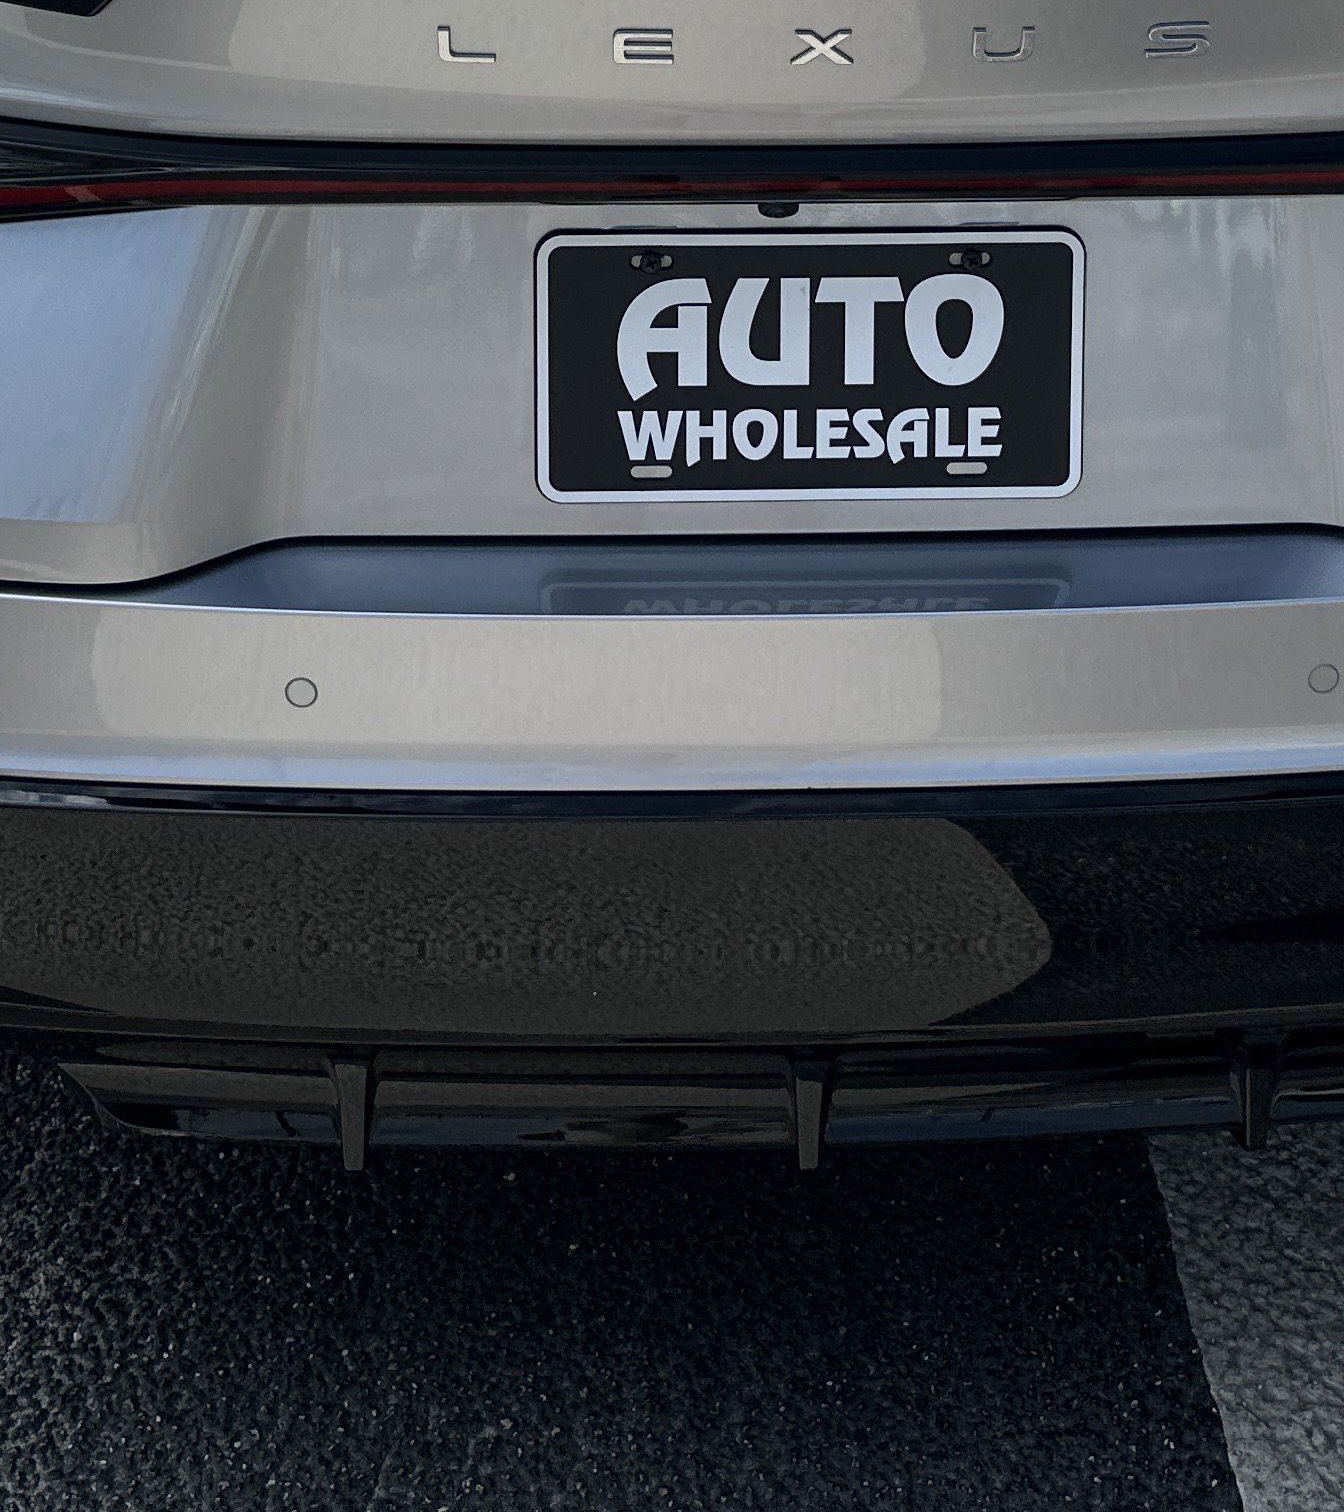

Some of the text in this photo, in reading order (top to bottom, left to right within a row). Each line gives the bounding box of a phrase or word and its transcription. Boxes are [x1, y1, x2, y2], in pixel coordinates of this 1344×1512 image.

[436, 19, 1213, 66] LEXUS
[616, 273, 1005, 401] AUTO
[616, 406, 1004, 467] WHOLESALE
